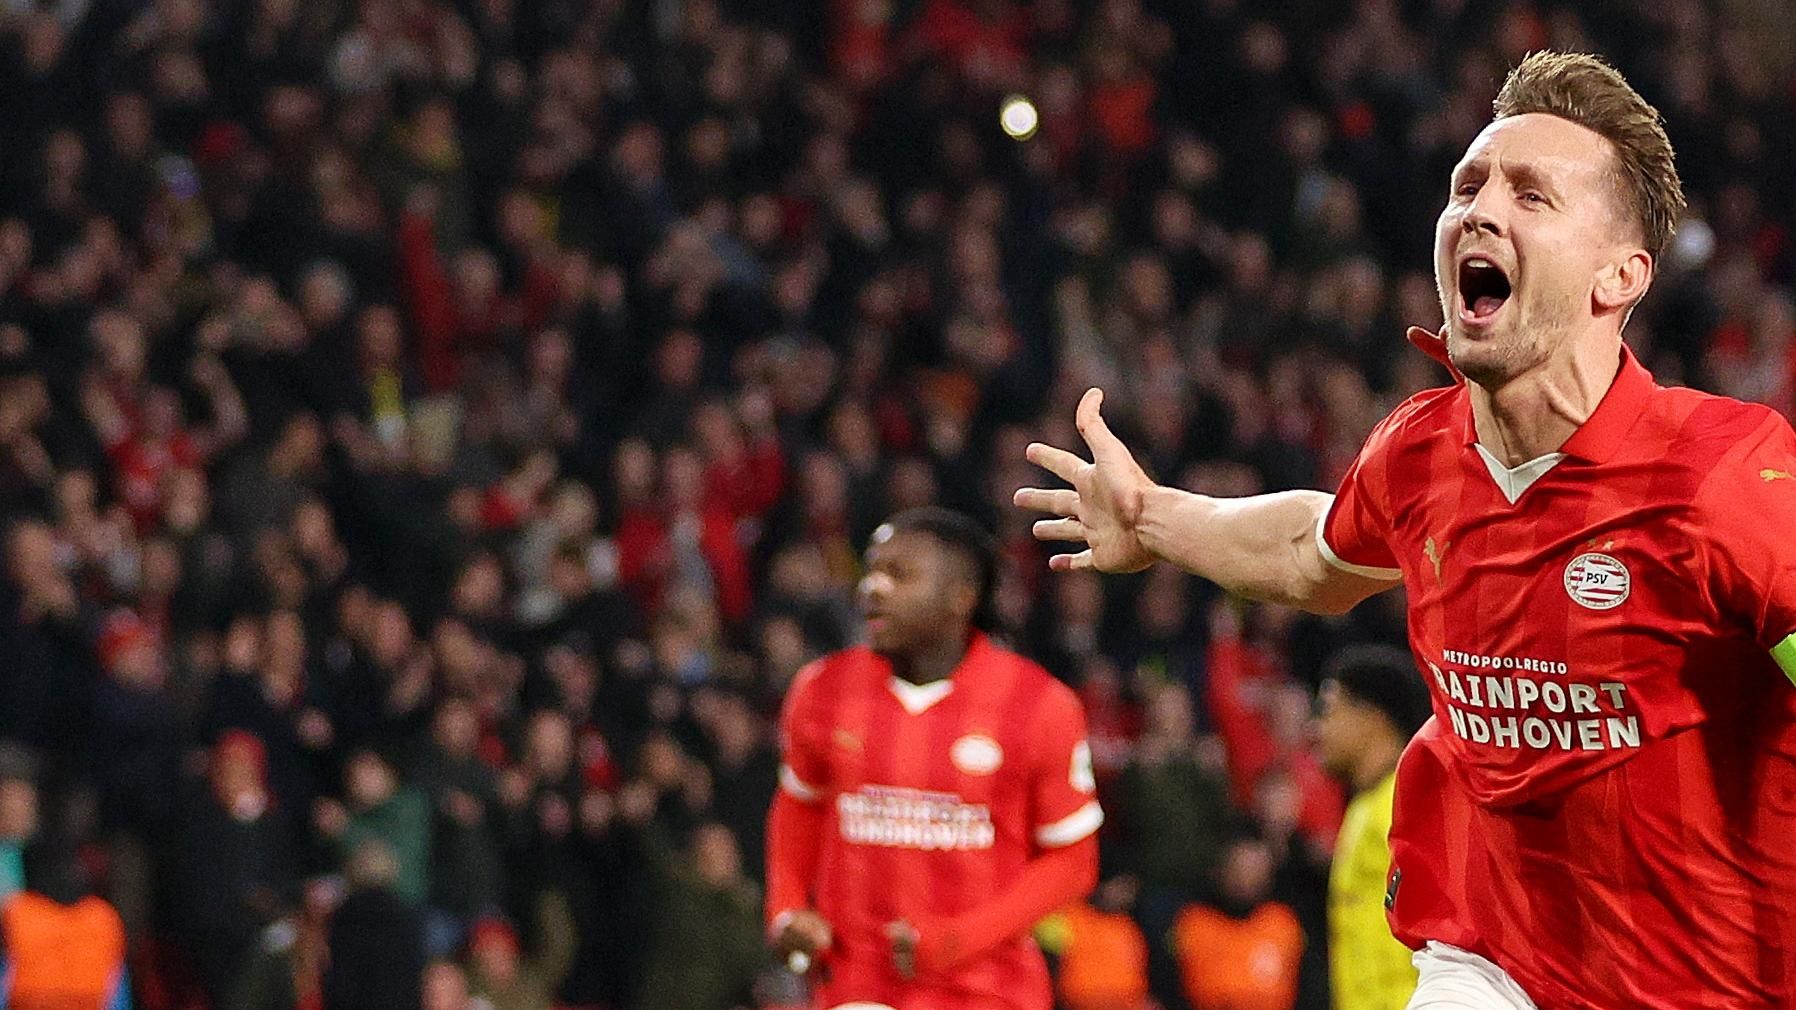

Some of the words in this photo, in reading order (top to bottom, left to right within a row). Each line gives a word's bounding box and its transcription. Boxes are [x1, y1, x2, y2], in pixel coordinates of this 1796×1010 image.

[1586, 572, 1609, 585] PSV
[1424, 657, 1627, 714] RAINPORT
[1447, 703, 1641, 751] NDHOVEN
